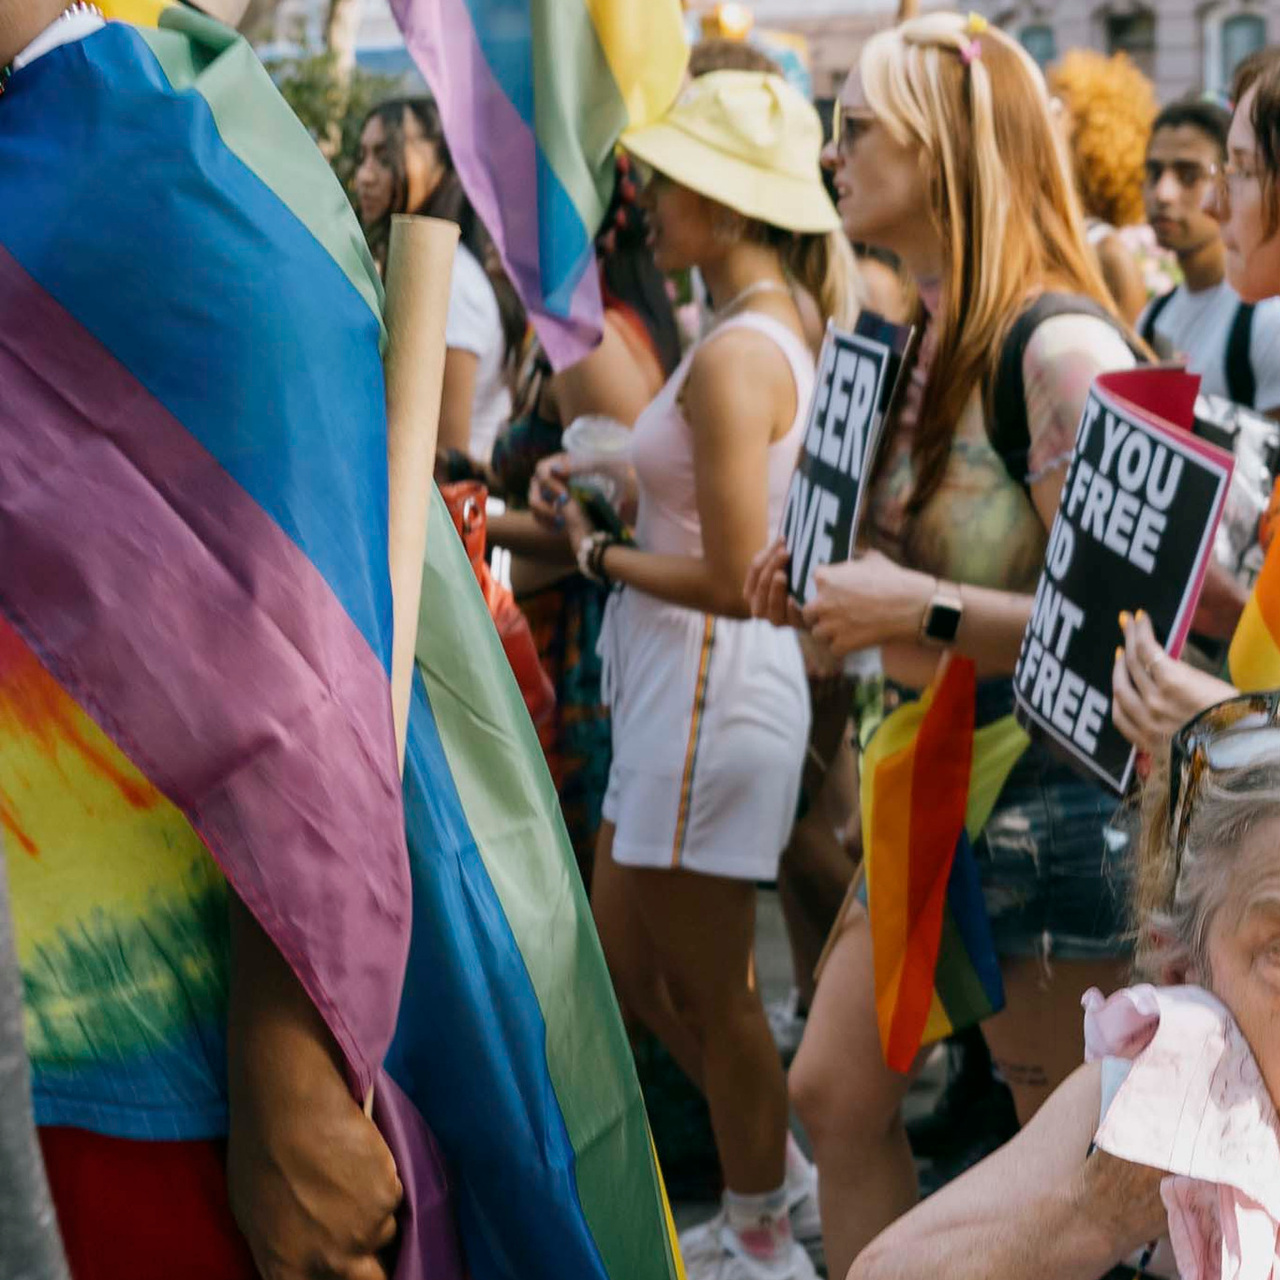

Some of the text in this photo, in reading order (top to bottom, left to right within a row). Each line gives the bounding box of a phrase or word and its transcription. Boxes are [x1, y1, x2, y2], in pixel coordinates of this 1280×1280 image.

[1066, 458, 1168, 575] FREE
[1098, 413, 1185, 511] YOU
[1019, 636, 1110, 755] FREE
